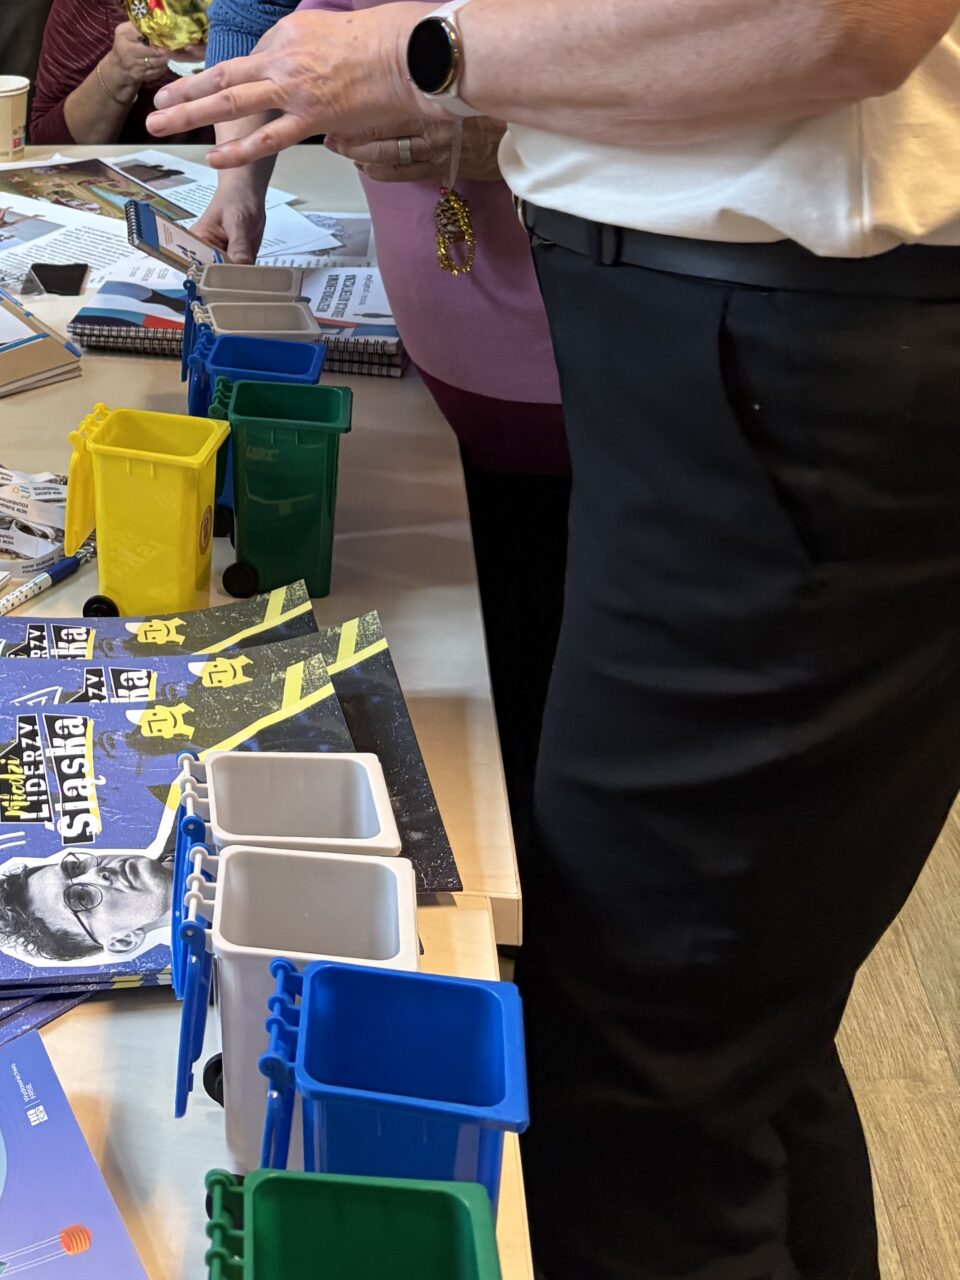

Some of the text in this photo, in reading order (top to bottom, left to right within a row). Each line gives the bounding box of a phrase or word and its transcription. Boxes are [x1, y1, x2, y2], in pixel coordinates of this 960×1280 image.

[16, 507, 28, 515] NEW
[18, 721, 50, 823] LIDERZY
[44, 716, 106, 840] Śląska
